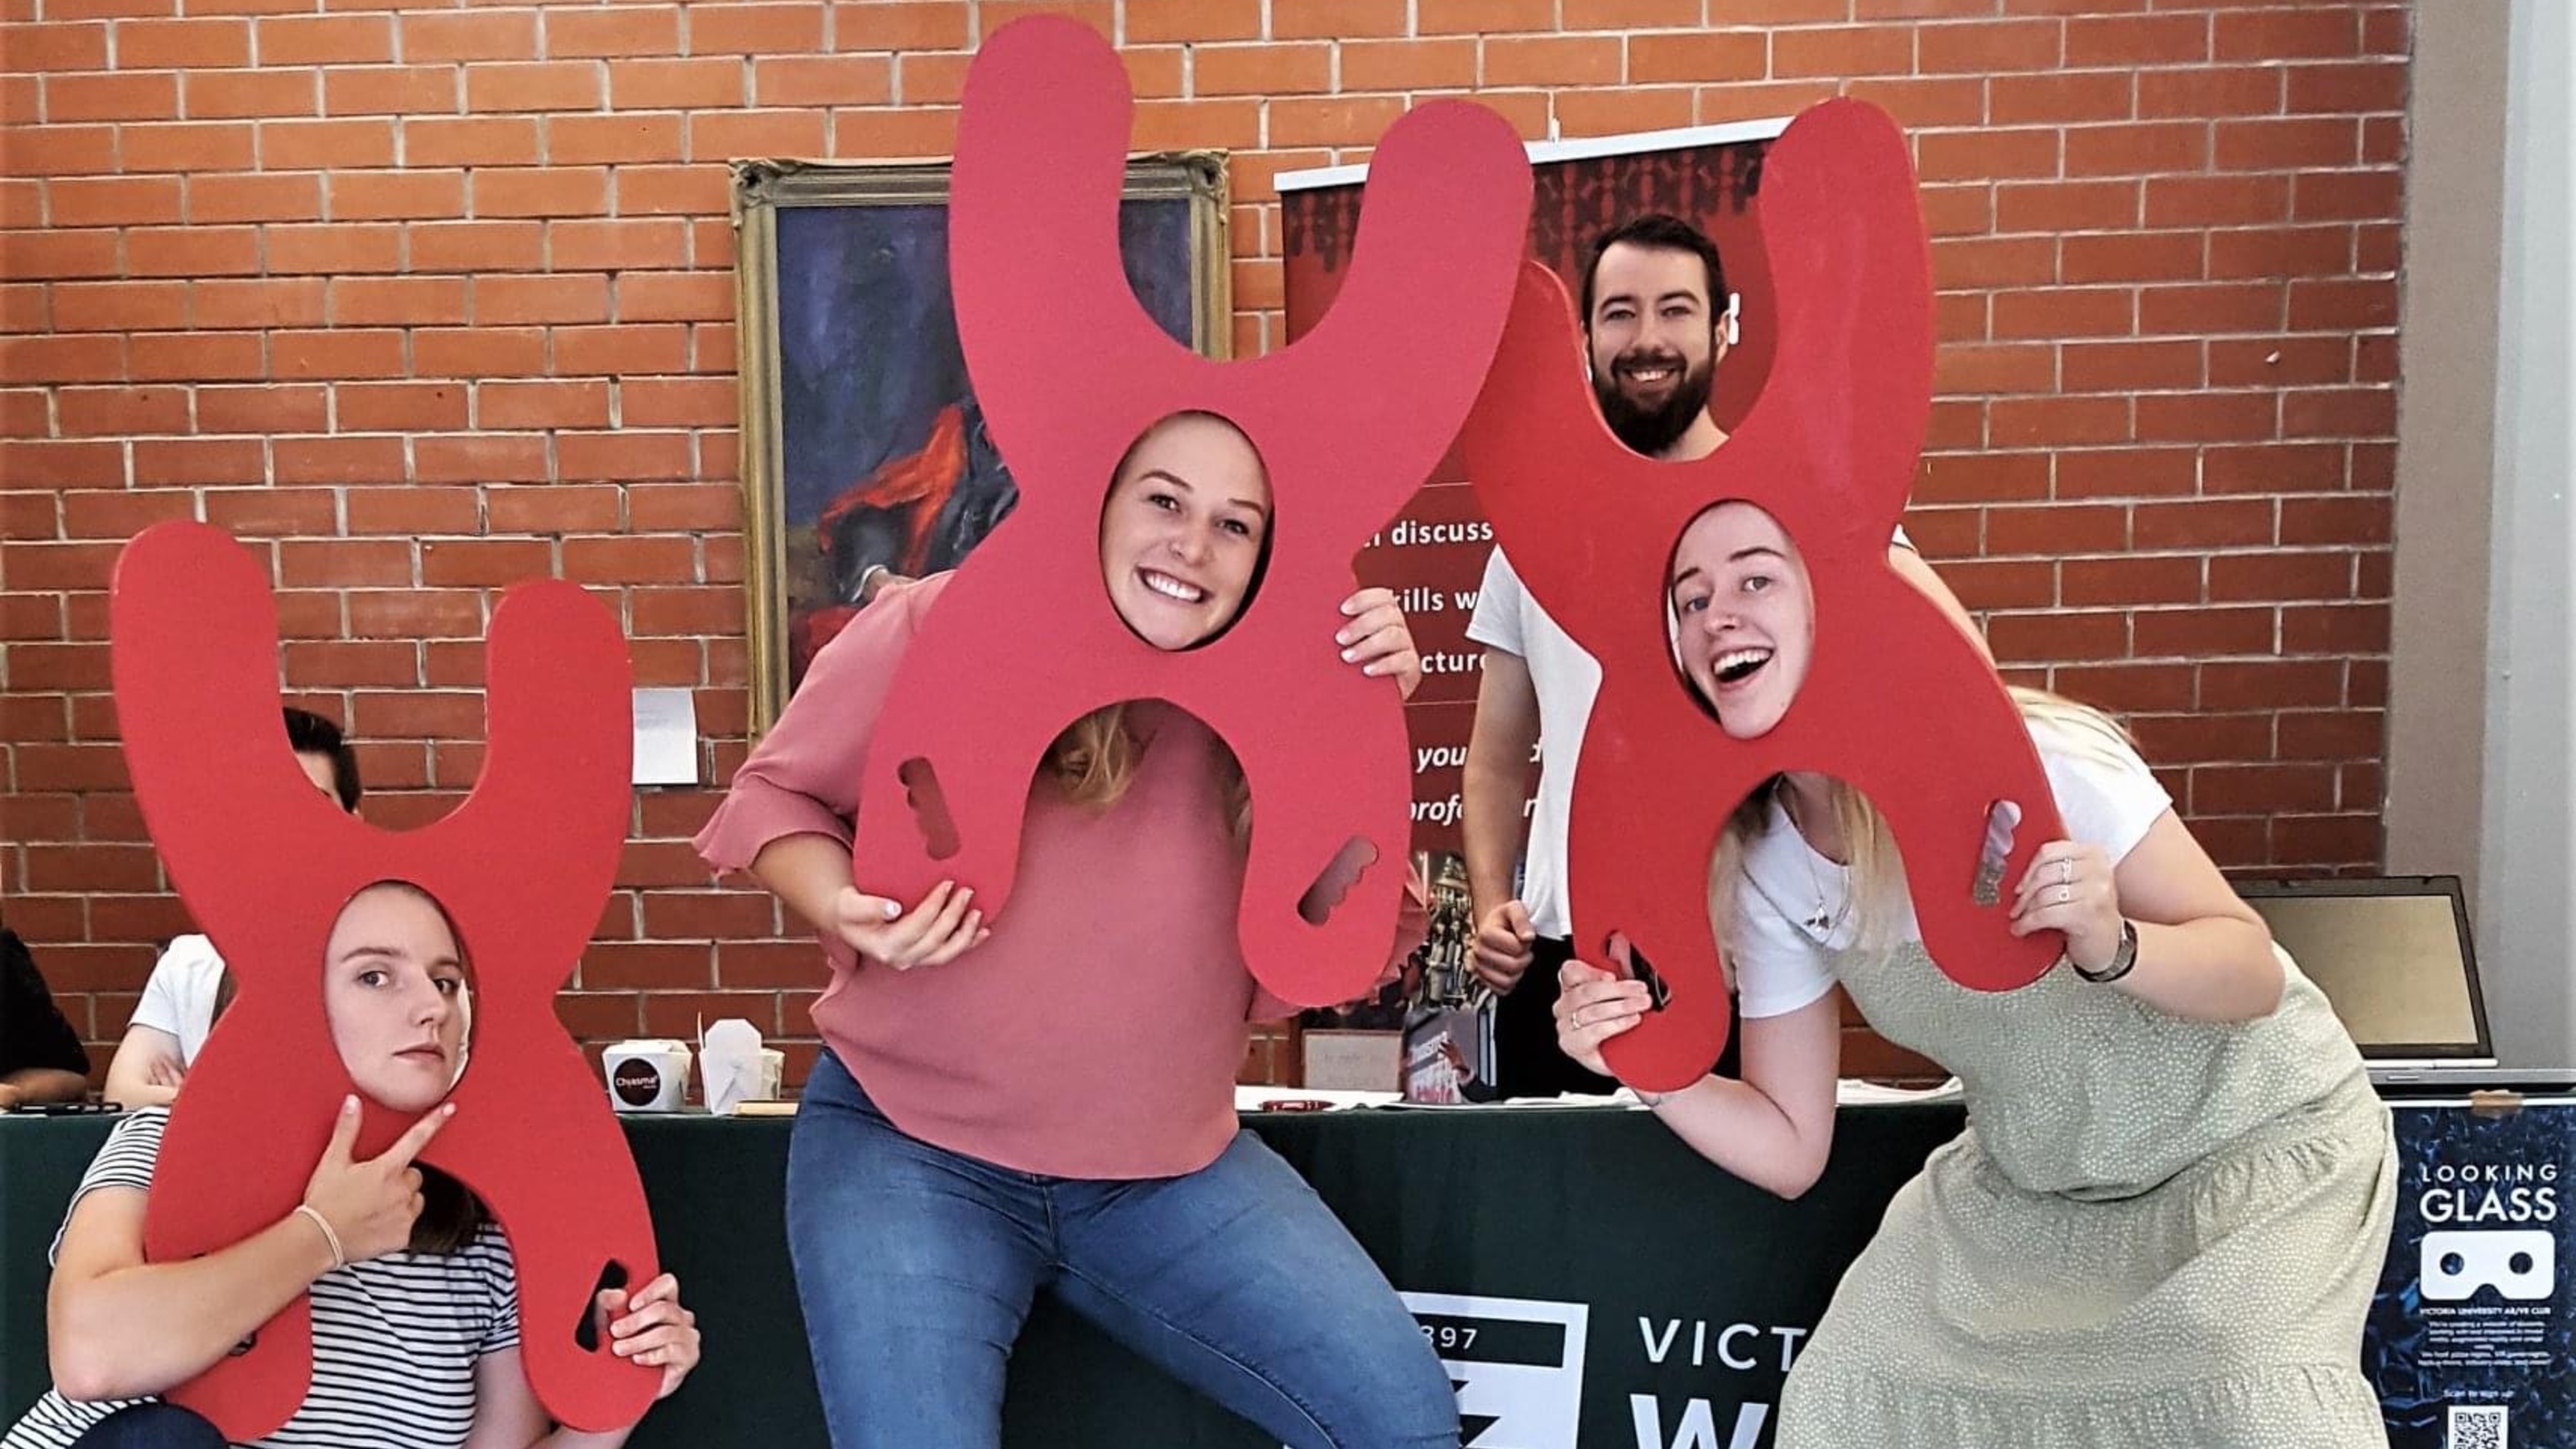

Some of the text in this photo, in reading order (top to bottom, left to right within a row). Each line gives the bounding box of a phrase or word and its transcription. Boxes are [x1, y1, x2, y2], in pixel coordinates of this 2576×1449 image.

[1391, 520, 1493, 545] discuss
[2423, 1164, 2557, 1183] LOOKING
[2420, 1187, 2557, 1223] GLASS
